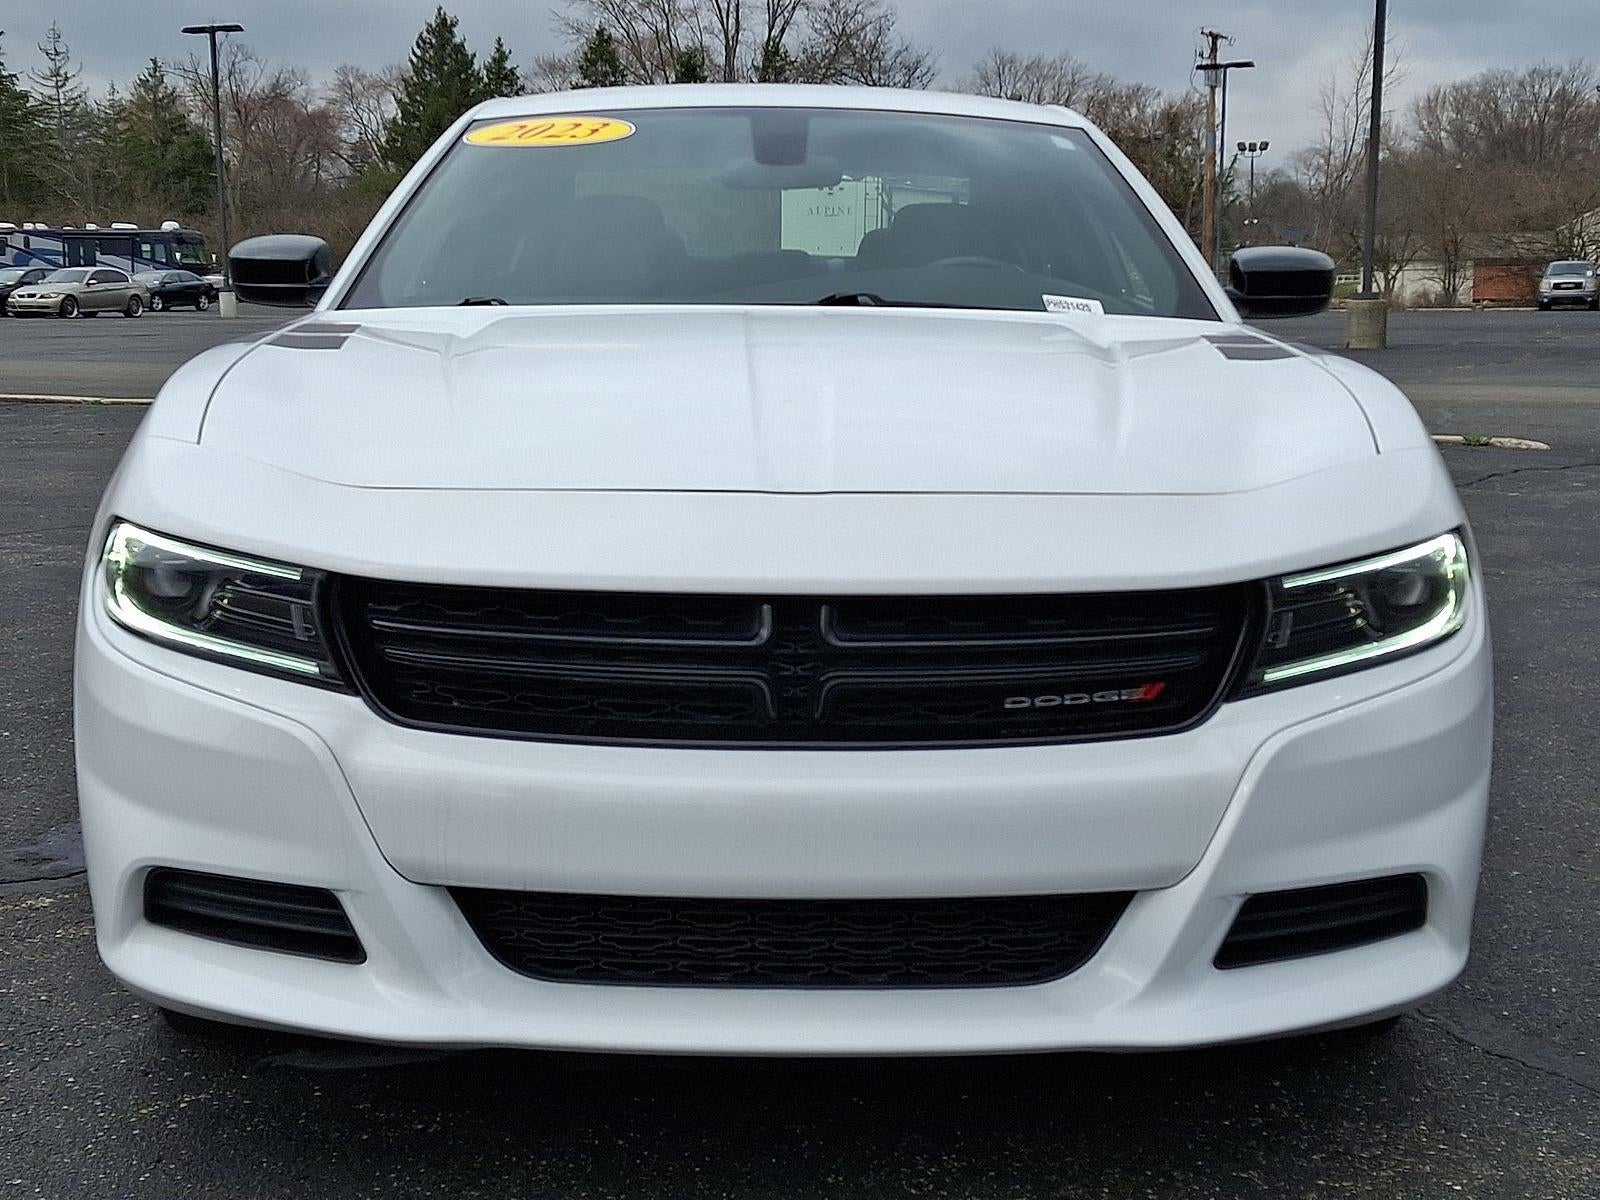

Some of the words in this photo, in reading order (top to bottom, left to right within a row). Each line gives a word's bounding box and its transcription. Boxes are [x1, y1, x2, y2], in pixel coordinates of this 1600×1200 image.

[487, 122, 610, 141] 2023
[807, 205, 852, 215] ALPINE
[1004, 689, 1144, 708] DODGE
